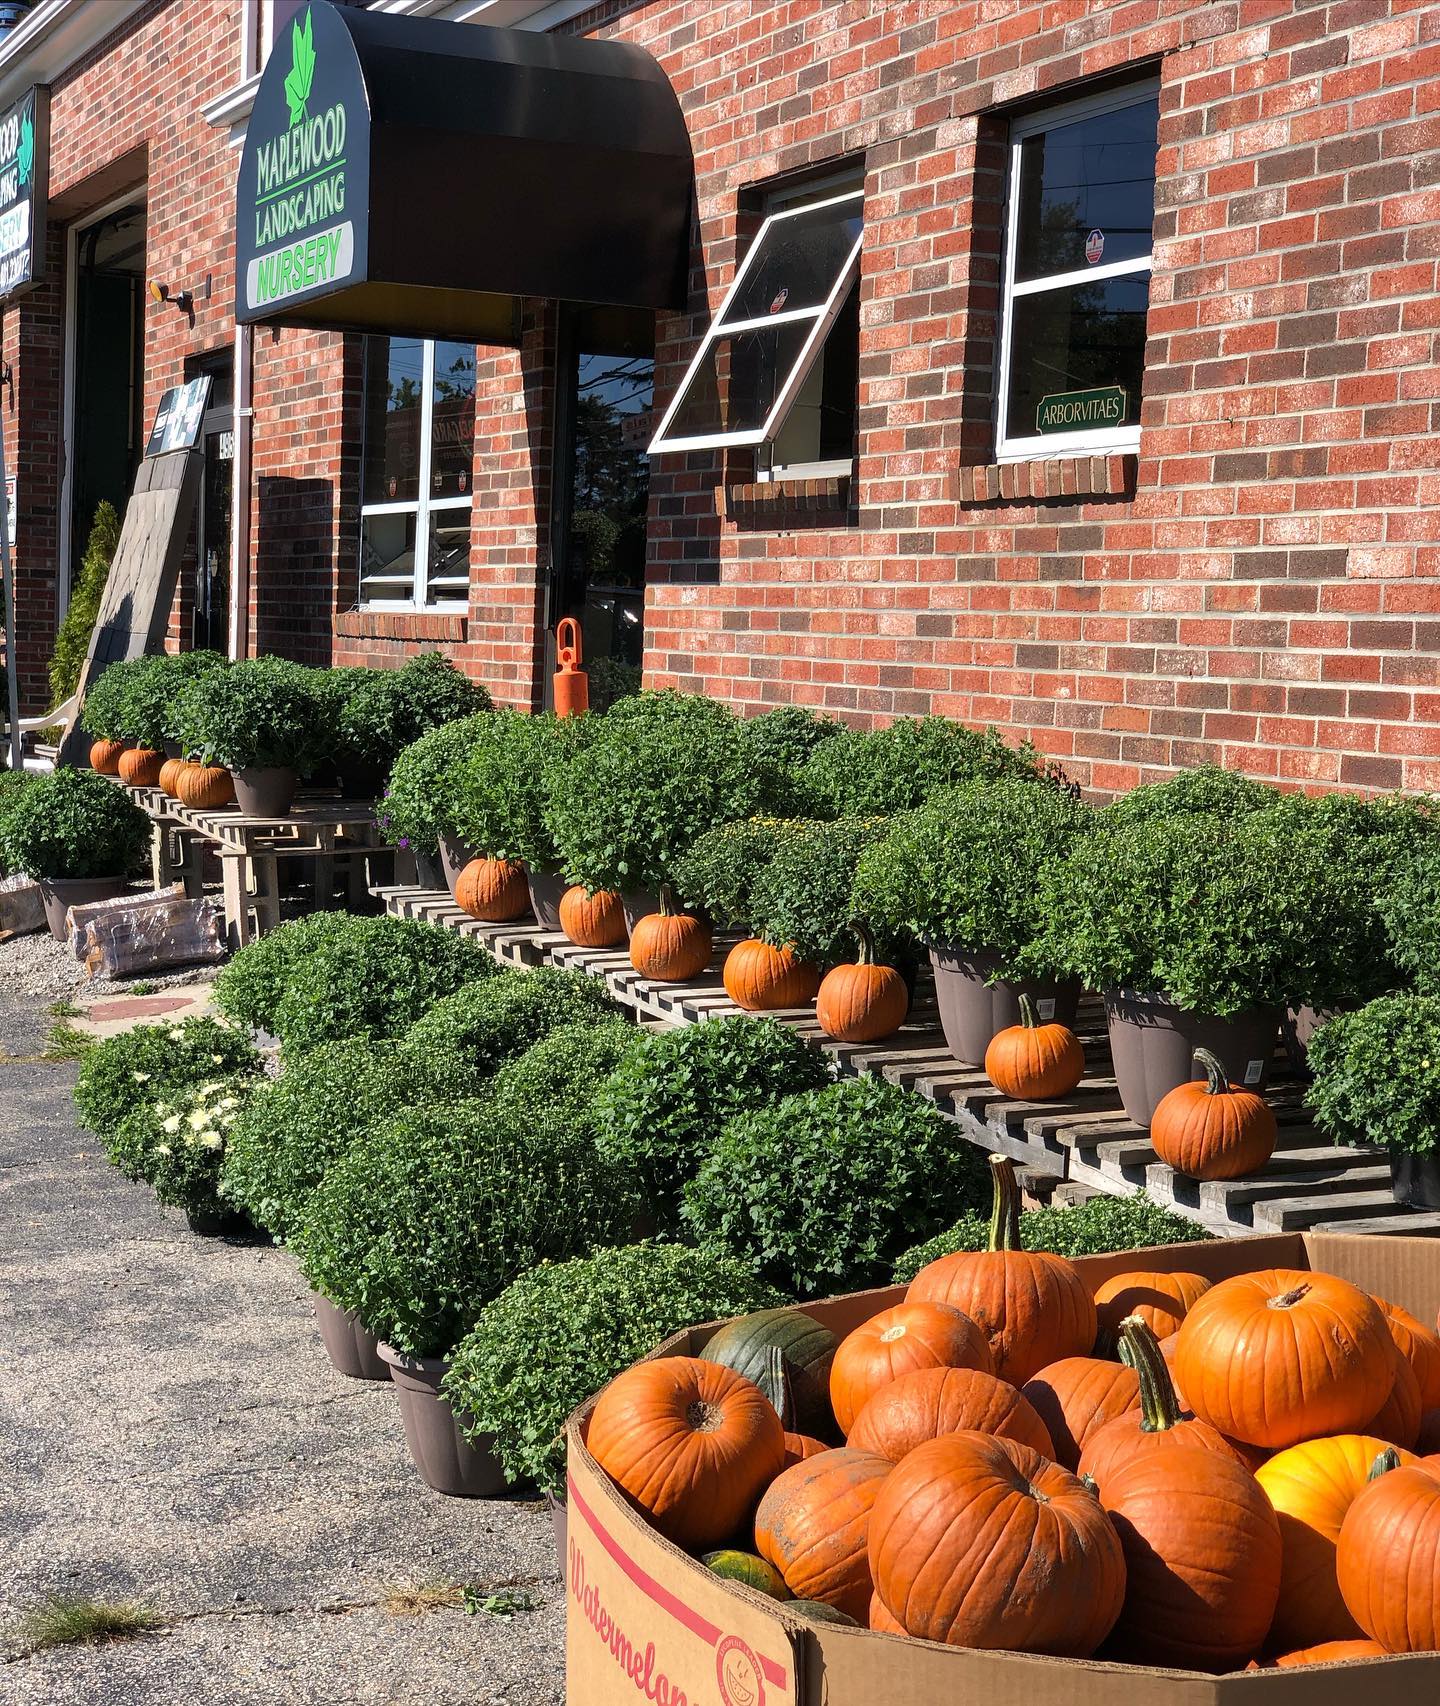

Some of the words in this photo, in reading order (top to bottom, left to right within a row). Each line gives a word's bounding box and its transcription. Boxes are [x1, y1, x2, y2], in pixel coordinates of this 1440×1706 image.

[256, 103, 346, 196] MAPLEWOOD
[255, 171, 345, 249] LANDSCAPING
[256, 228, 342, 304] NURSERY
[1041, 397, 1119, 425] ARBORVITAES
[569, 1535, 700, 1706] Watermelon
